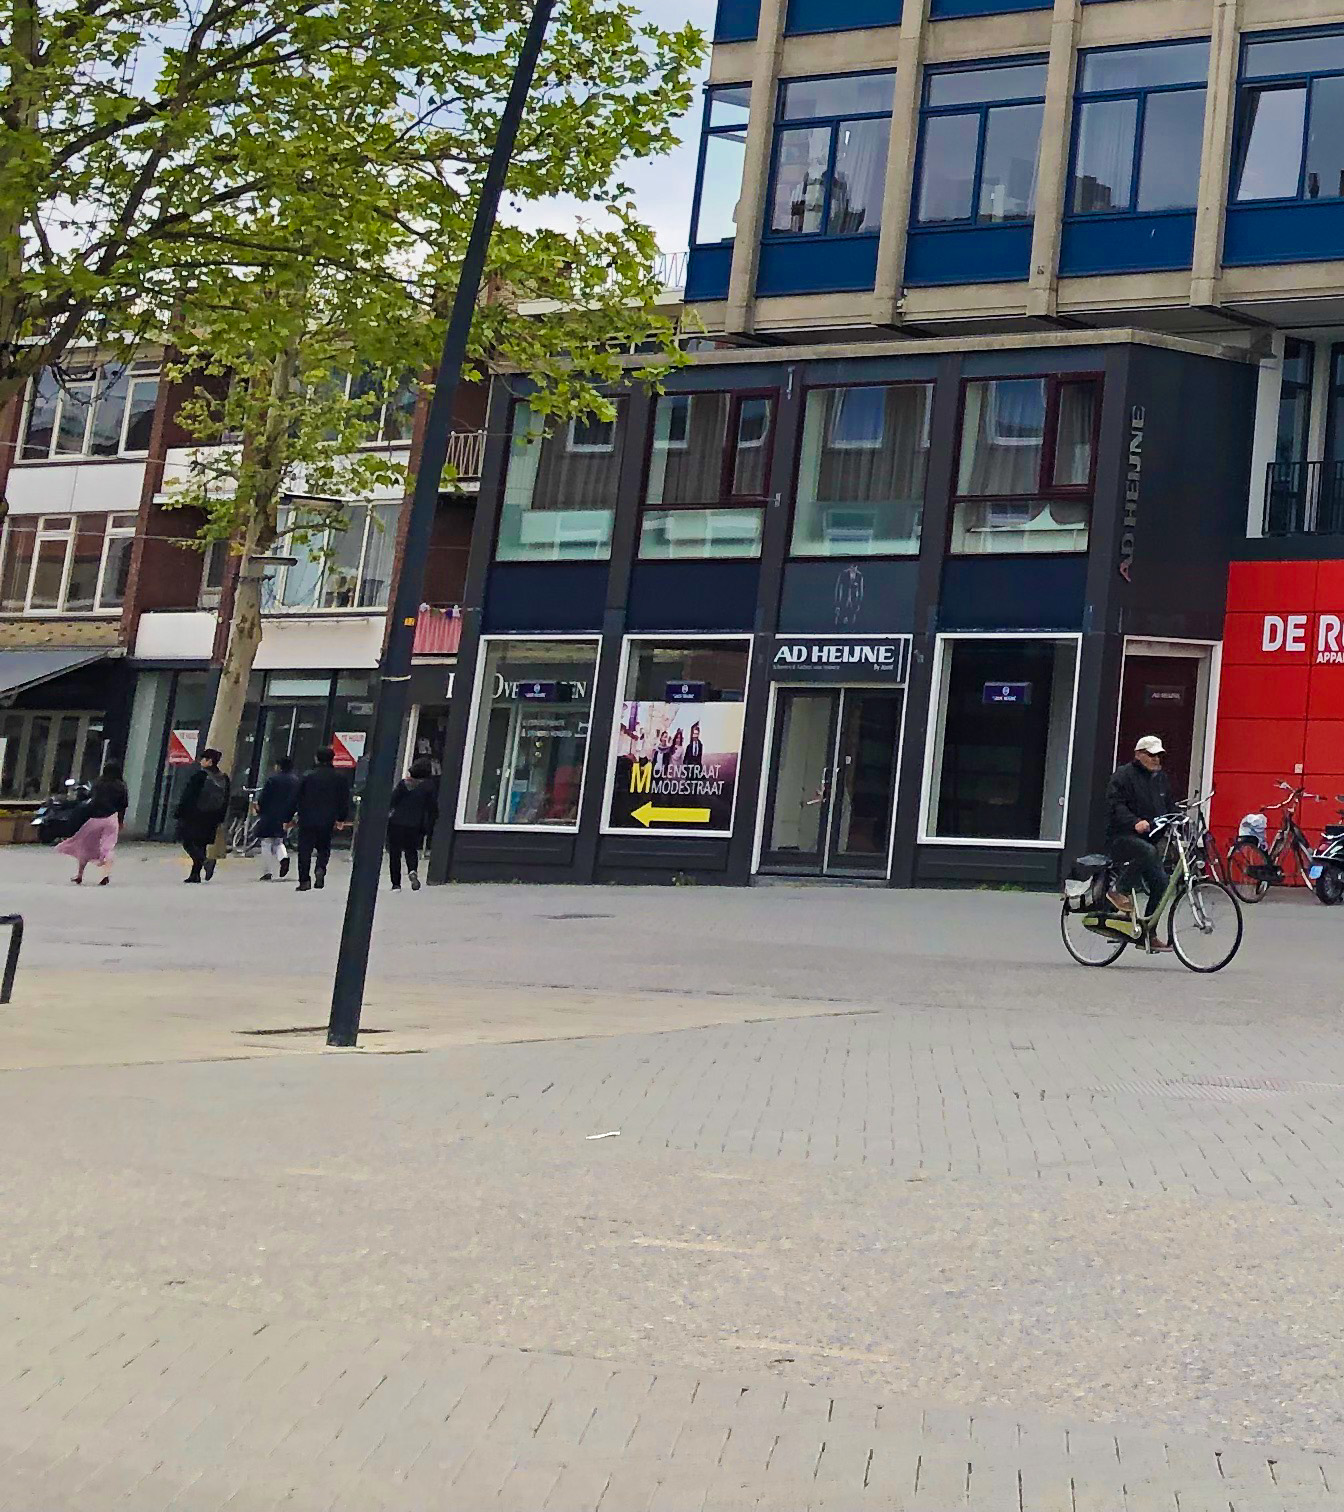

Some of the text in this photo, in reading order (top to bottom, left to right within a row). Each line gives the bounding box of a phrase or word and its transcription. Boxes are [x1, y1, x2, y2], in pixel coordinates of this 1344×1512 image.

[1262, 614, 1307, 652] DE
[773, 645, 895, 663] AD HEIJNE
[651, 780, 725, 795] MODESTRAAT
